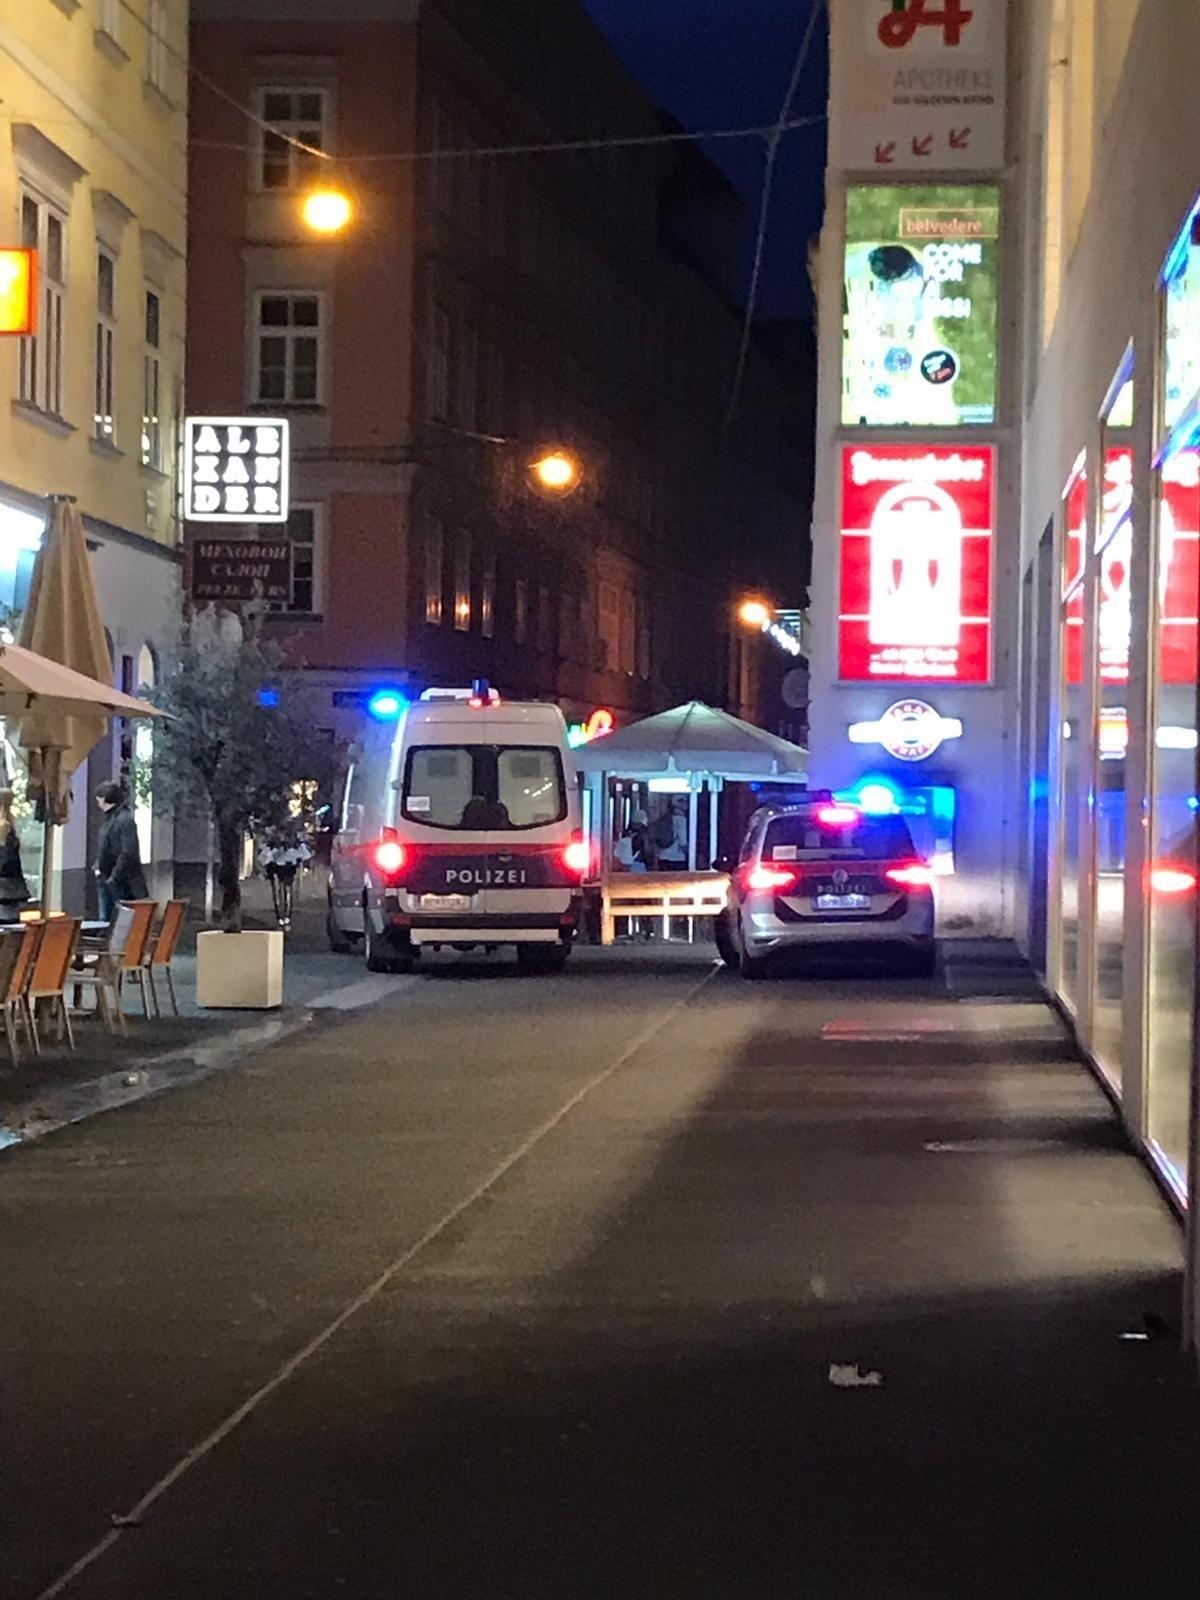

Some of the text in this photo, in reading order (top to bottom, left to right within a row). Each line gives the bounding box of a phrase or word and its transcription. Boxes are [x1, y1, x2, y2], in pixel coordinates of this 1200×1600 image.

[893, 68, 993, 90] APOTHEKE
[906, 218, 982, 233] belvedere
[194, 426, 280, 454] ALE
[194, 455, 280, 484] XAN
[194, 486, 280, 513] DER
[446, 869, 526, 884] POLIZEI
